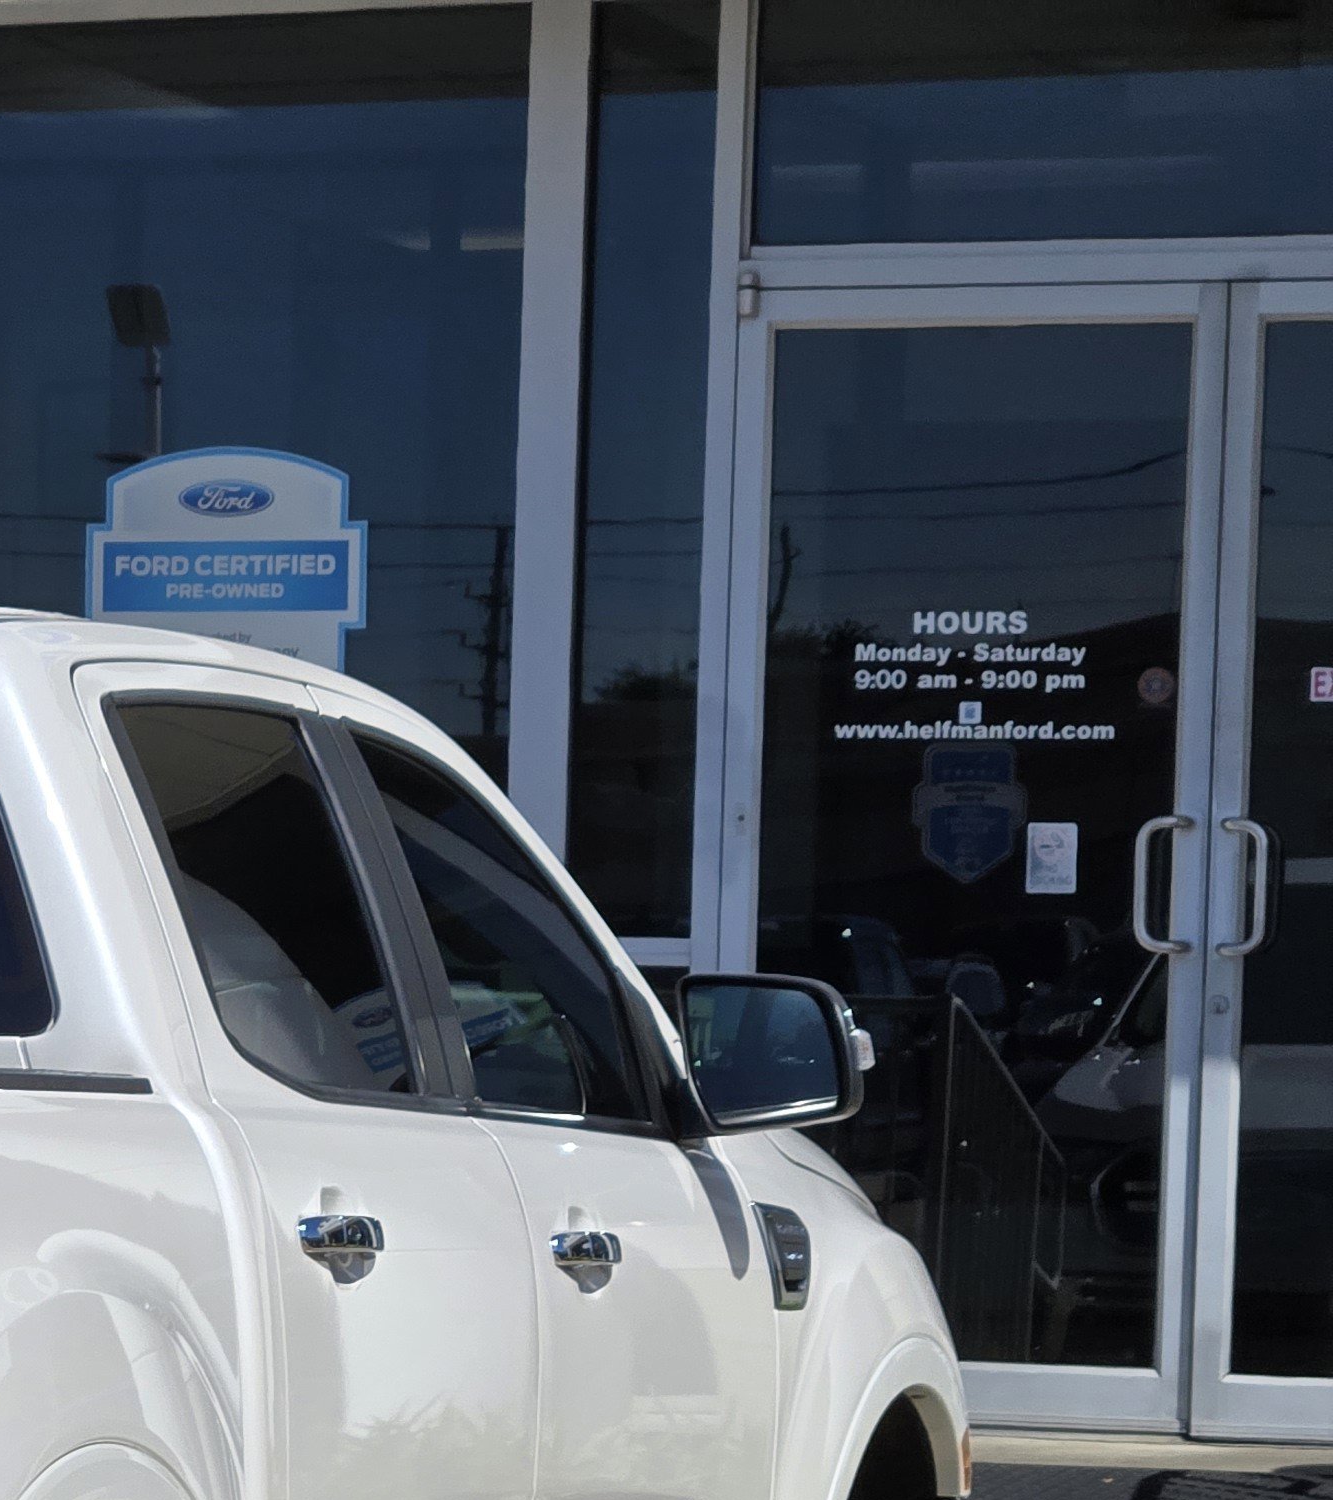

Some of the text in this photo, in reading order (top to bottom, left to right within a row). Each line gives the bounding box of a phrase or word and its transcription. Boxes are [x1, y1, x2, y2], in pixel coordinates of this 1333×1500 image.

[196, 485, 255, 510] Ford
[114, 554, 337, 577] FORD CERTIFIED
[165, 583, 285, 599] PRE-OWNED
[912, 610, 1029, 635] HOURS
[854, 643, 952, 667] Monday
[973, 642, 1087, 667] Saturday
[854, 669, 908, 690] 9:00
[916, 673, 958, 690] am
[981, 669, 1038, 690] 9:00
[1044, 673, 1086, 693] pm
[834, 720, 1116, 741] www.helfmanford.com
